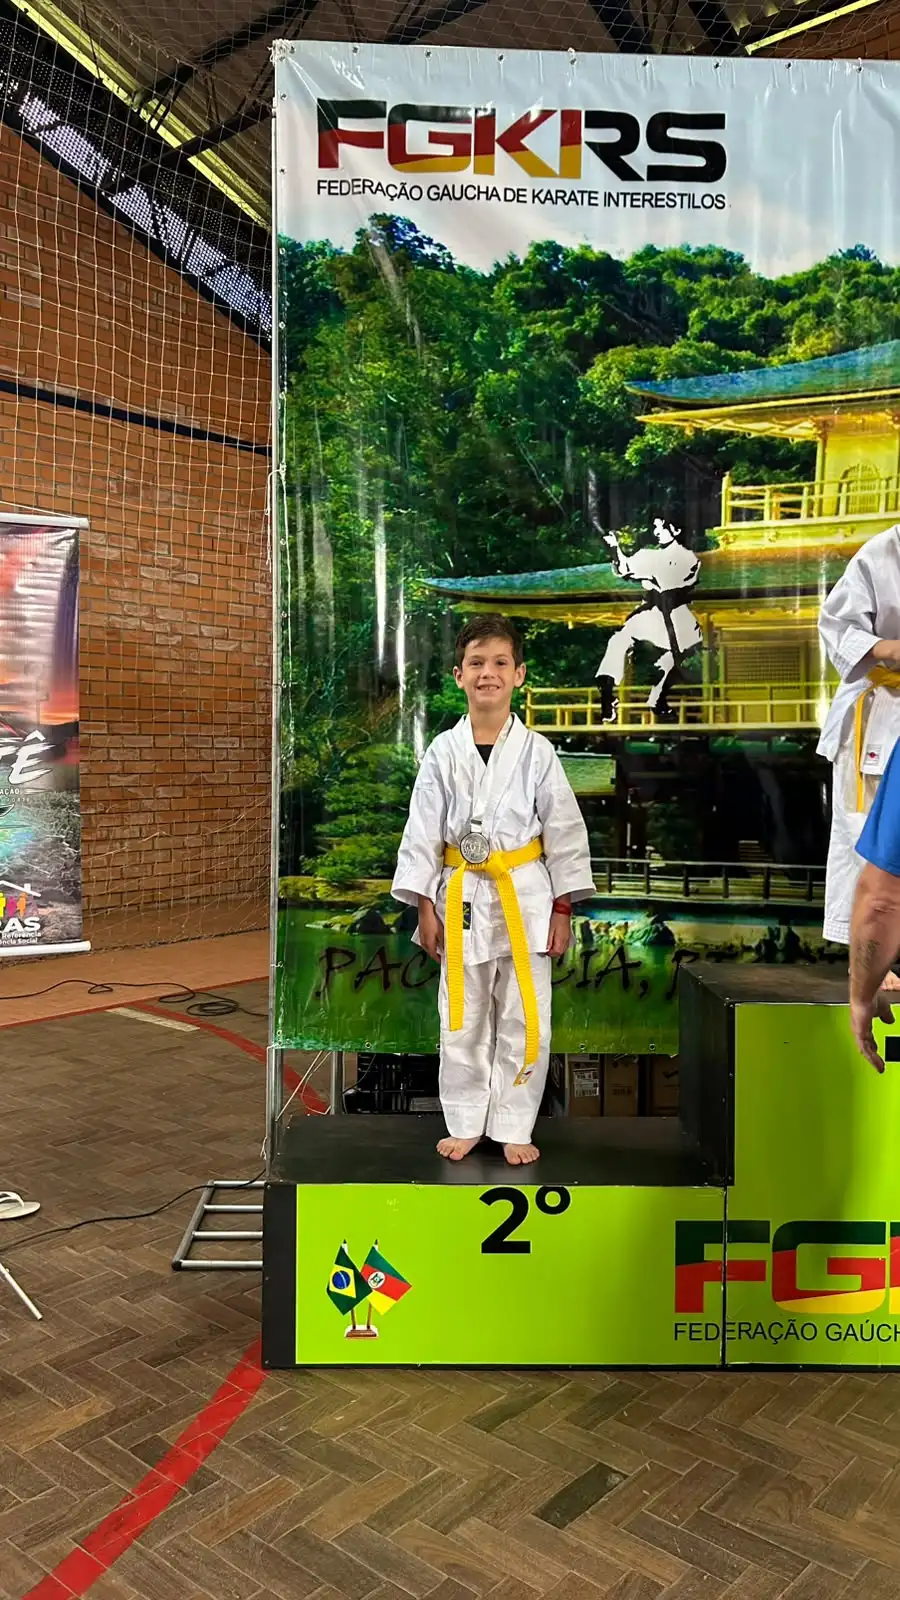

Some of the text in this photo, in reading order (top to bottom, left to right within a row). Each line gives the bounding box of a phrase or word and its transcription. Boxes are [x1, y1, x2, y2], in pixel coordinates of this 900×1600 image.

[317, 98, 727, 183] FGKIRS
[317, 178, 726, 209] FEDERAÇÃO GAUCHA DE KARATE INTERESTILOS
[0, 917, 41, 932] AS
[675, 1220, 900, 1314] FG
[674, 1319, 818, 1344] FEDERAÇÃO
